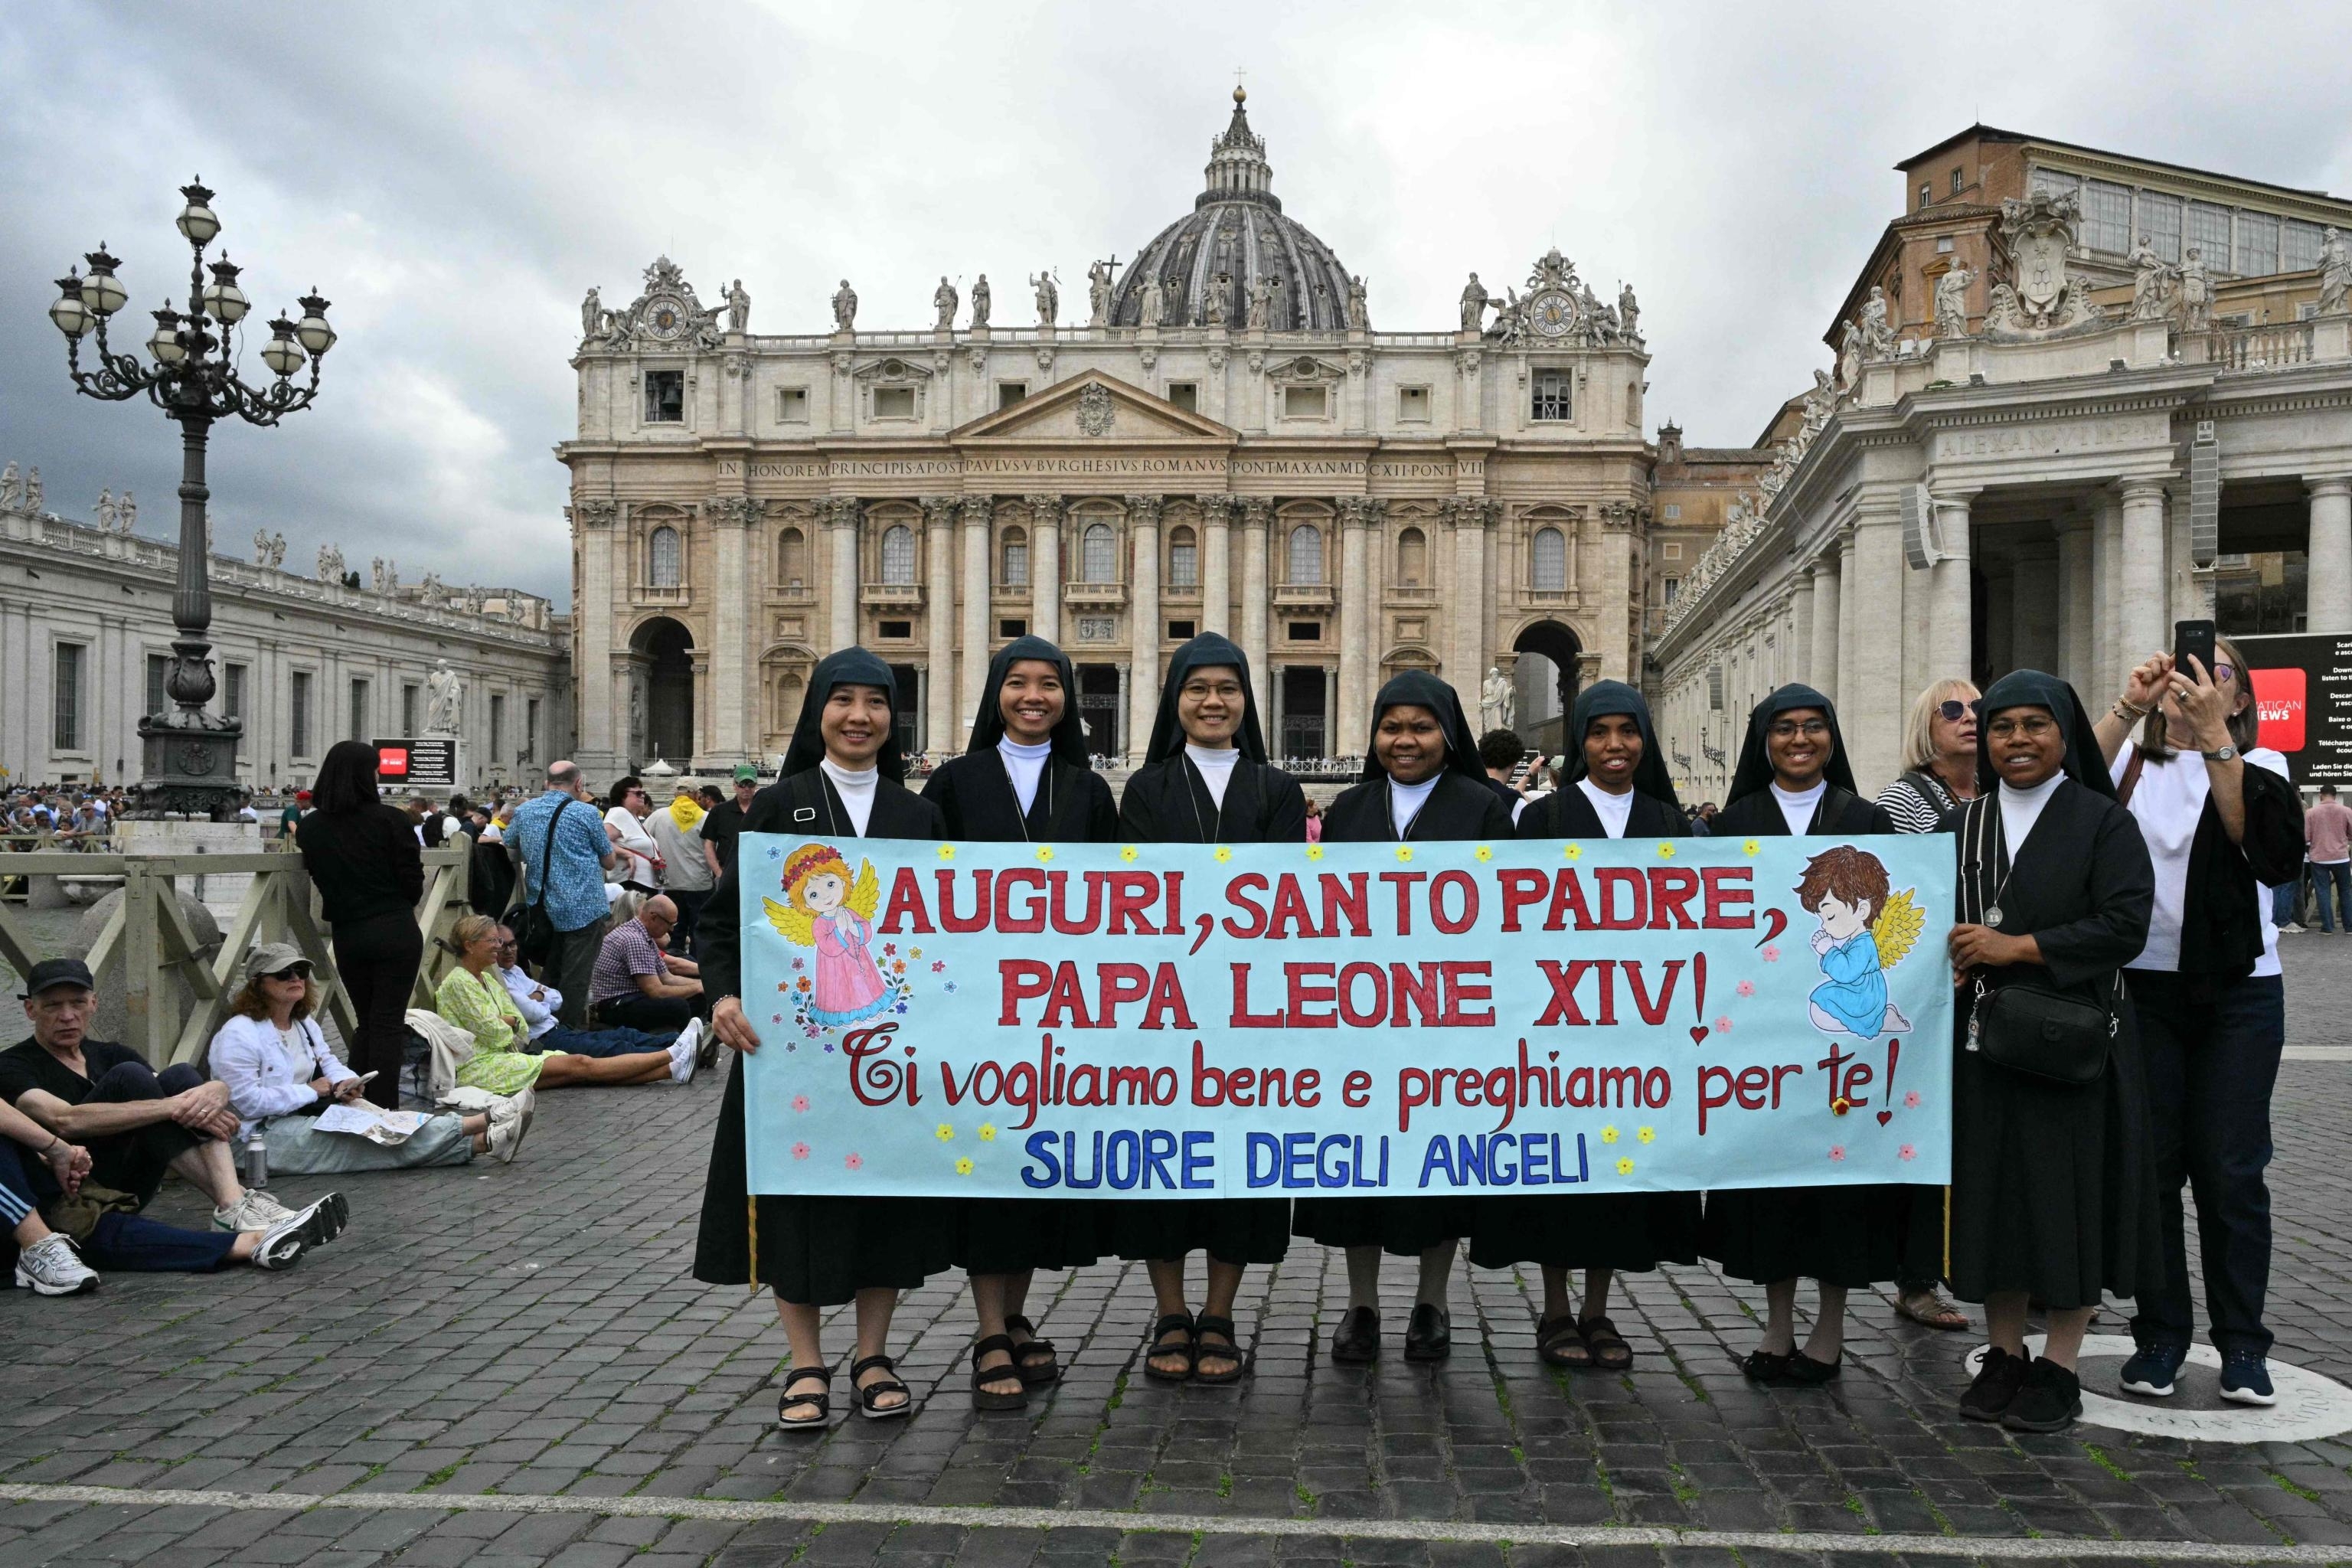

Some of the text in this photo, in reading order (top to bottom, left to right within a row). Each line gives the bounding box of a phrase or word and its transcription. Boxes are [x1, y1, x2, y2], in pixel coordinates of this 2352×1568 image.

[749, 465, 829, 476] HONOREM
[965, 459, 1019, 472] PAVLVS
[1037, 459, 1138, 472] BVRGHESIVS
[1143, 459, 1226, 472] ROMANVS
[1459, 462, 1483, 474] VII
[2256, 700, 2302, 710] ATICAN
[877, 867, 1788, 956] AUGURI, SANTO PADRE,
[998, 952, 1710, 1047] PAPA LEONE XIV!
[940, 1032, 1178, 1130] vogliamo
[1191, 1040, 1321, 1107] bene
[1342, 1070, 1372, 1107] e
[1398, 1037, 1671, 1135] preghiamo
[1697, 1065, 1803, 1135] per
[1817, 1038, 1901, 1128] te!
[1021, 1129, 1589, 1190] SUORE DEGLI ANGELI
